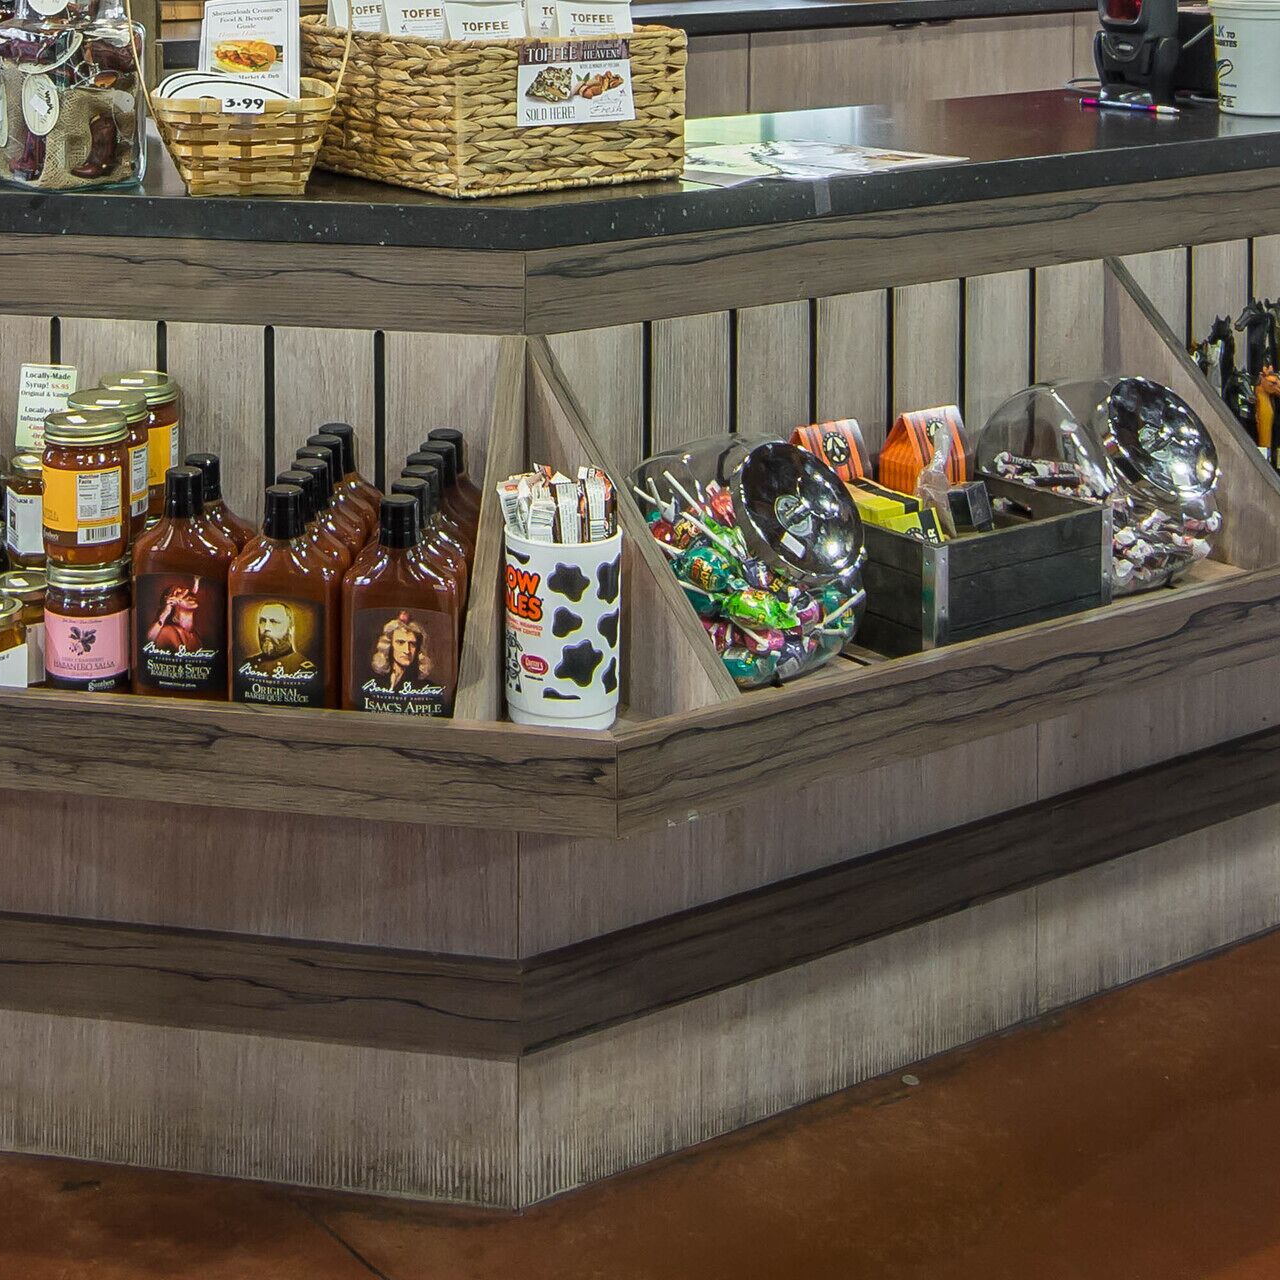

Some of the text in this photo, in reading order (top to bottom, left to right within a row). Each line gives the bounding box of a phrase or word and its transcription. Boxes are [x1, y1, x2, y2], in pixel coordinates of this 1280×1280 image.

[570, 12, 615, 24] TOFFEE
[462, 20, 510, 32] TOFFEE
[1226, 31, 1236, 39] TO
[526, 45, 577, 63] TOFFEE
[224, 98, 264, 109] 3.99
[526, 106, 575, 122] SOLD HERE!
[25, 371, 72, 380] Locally-Made
[26, 381, 49, 389] Syrup!
[506, 564, 541, 596] OW
[147, 659, 177, 671] SWEET
[185, 663, 211, 675] SPICY
[252, 683, 298, 697] ORIGINAL
[364, 697, 402, 712] ISAAC'S
[404, 701, 442, 714] APPLE
